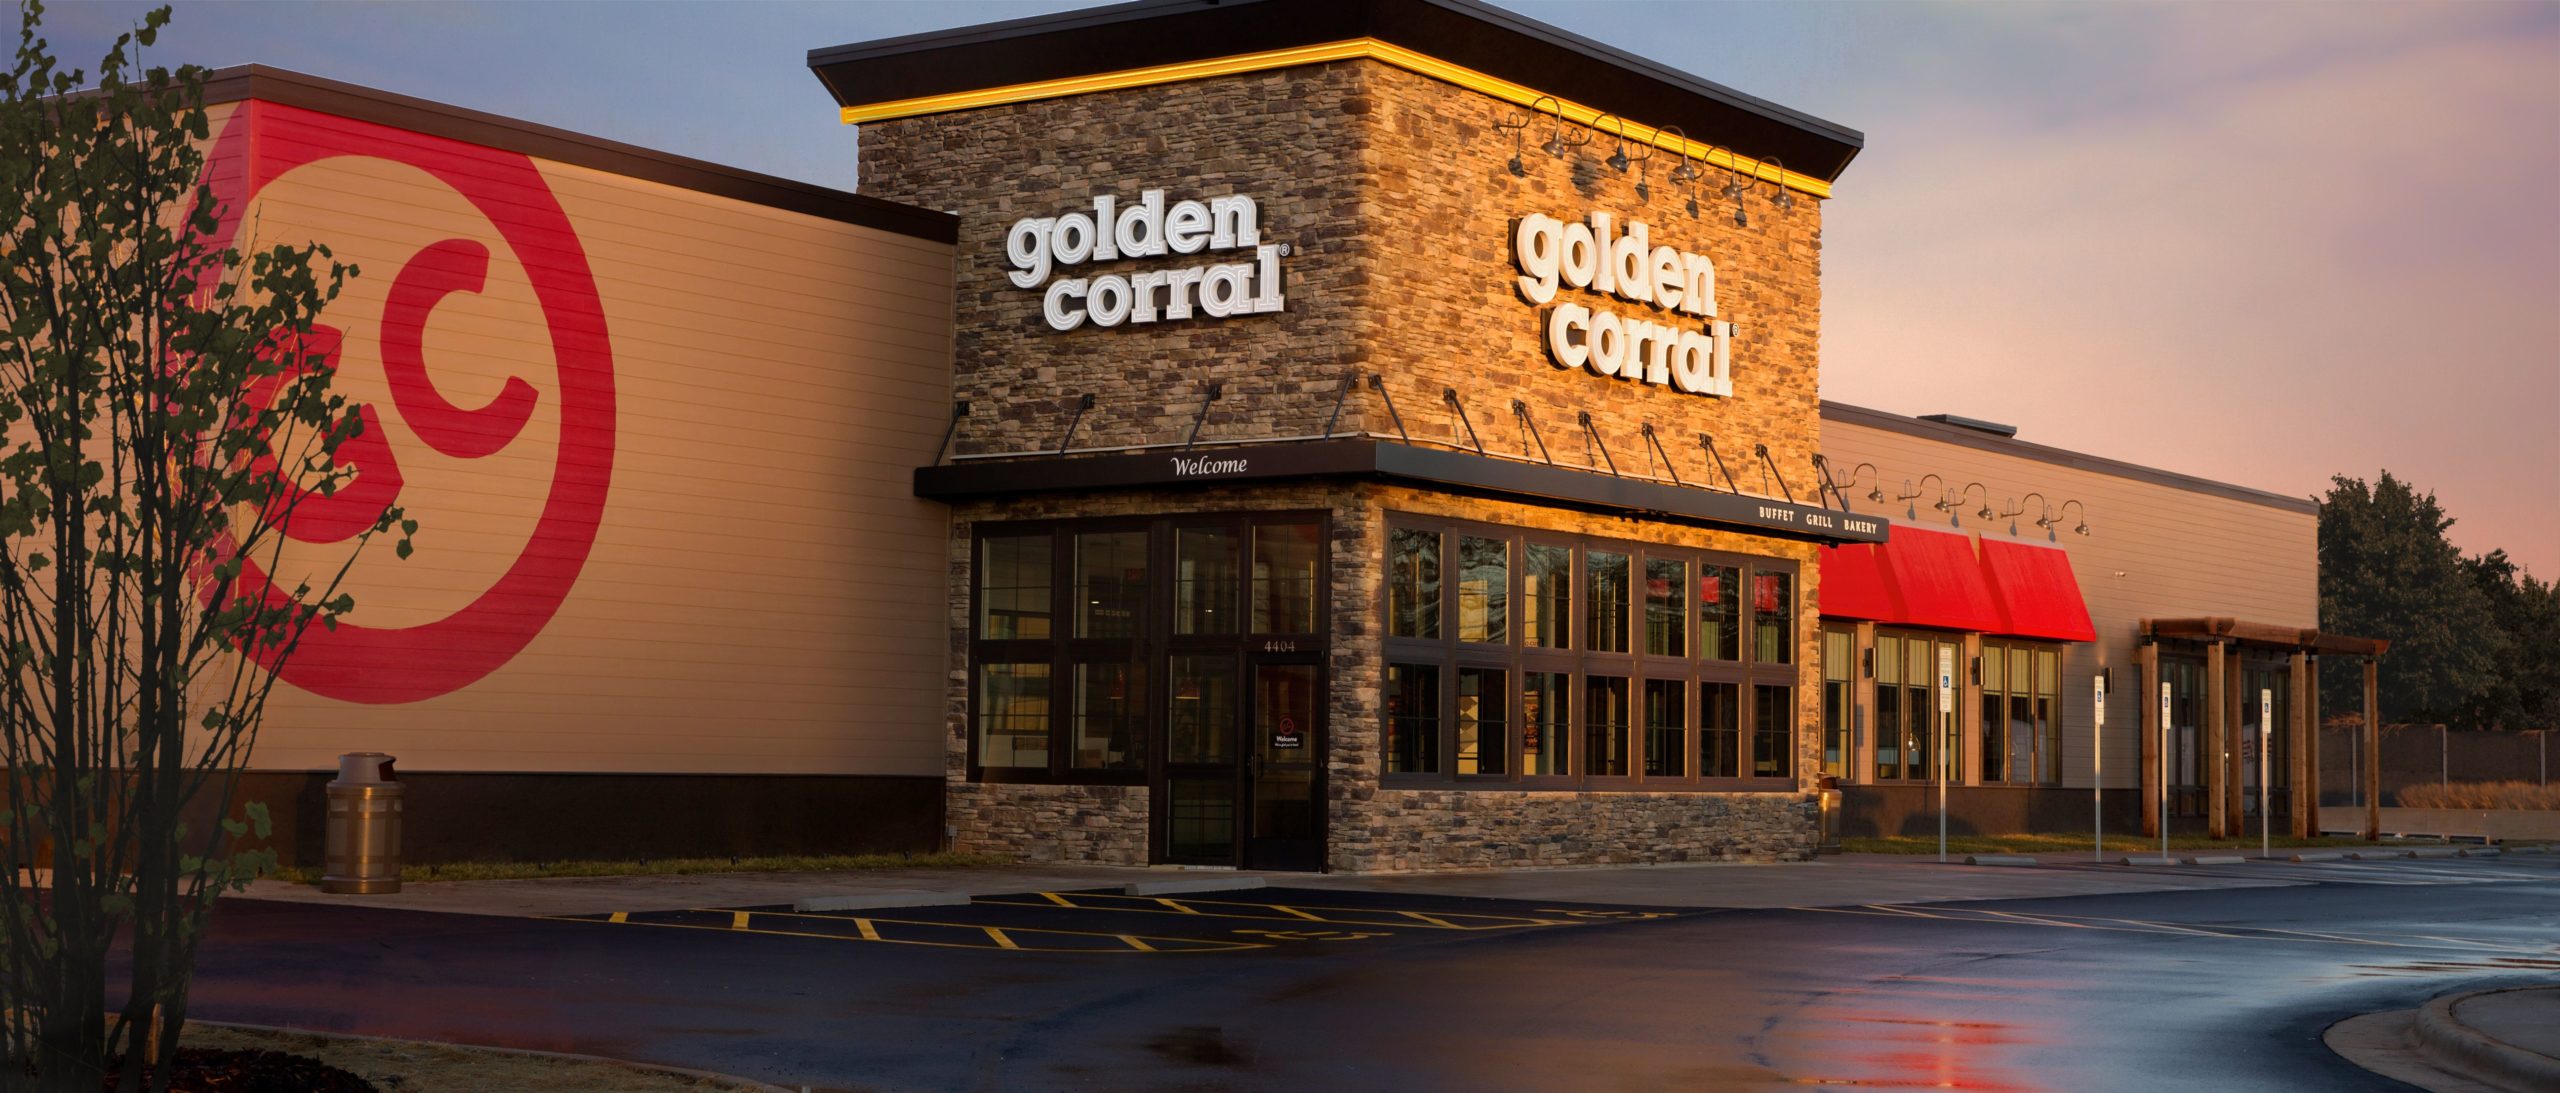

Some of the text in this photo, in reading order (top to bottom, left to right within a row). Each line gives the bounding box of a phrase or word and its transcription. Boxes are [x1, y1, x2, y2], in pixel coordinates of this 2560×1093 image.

[1007, 189, 1260, 288] golden
[1517, 211, 1717, 317] golden
[1170, 455, 1248, 476] Welcome
[1759, 506, 1877, 534] BUFFET GRILL BAKERY
[1264, 641, 1295, 652] 4404
